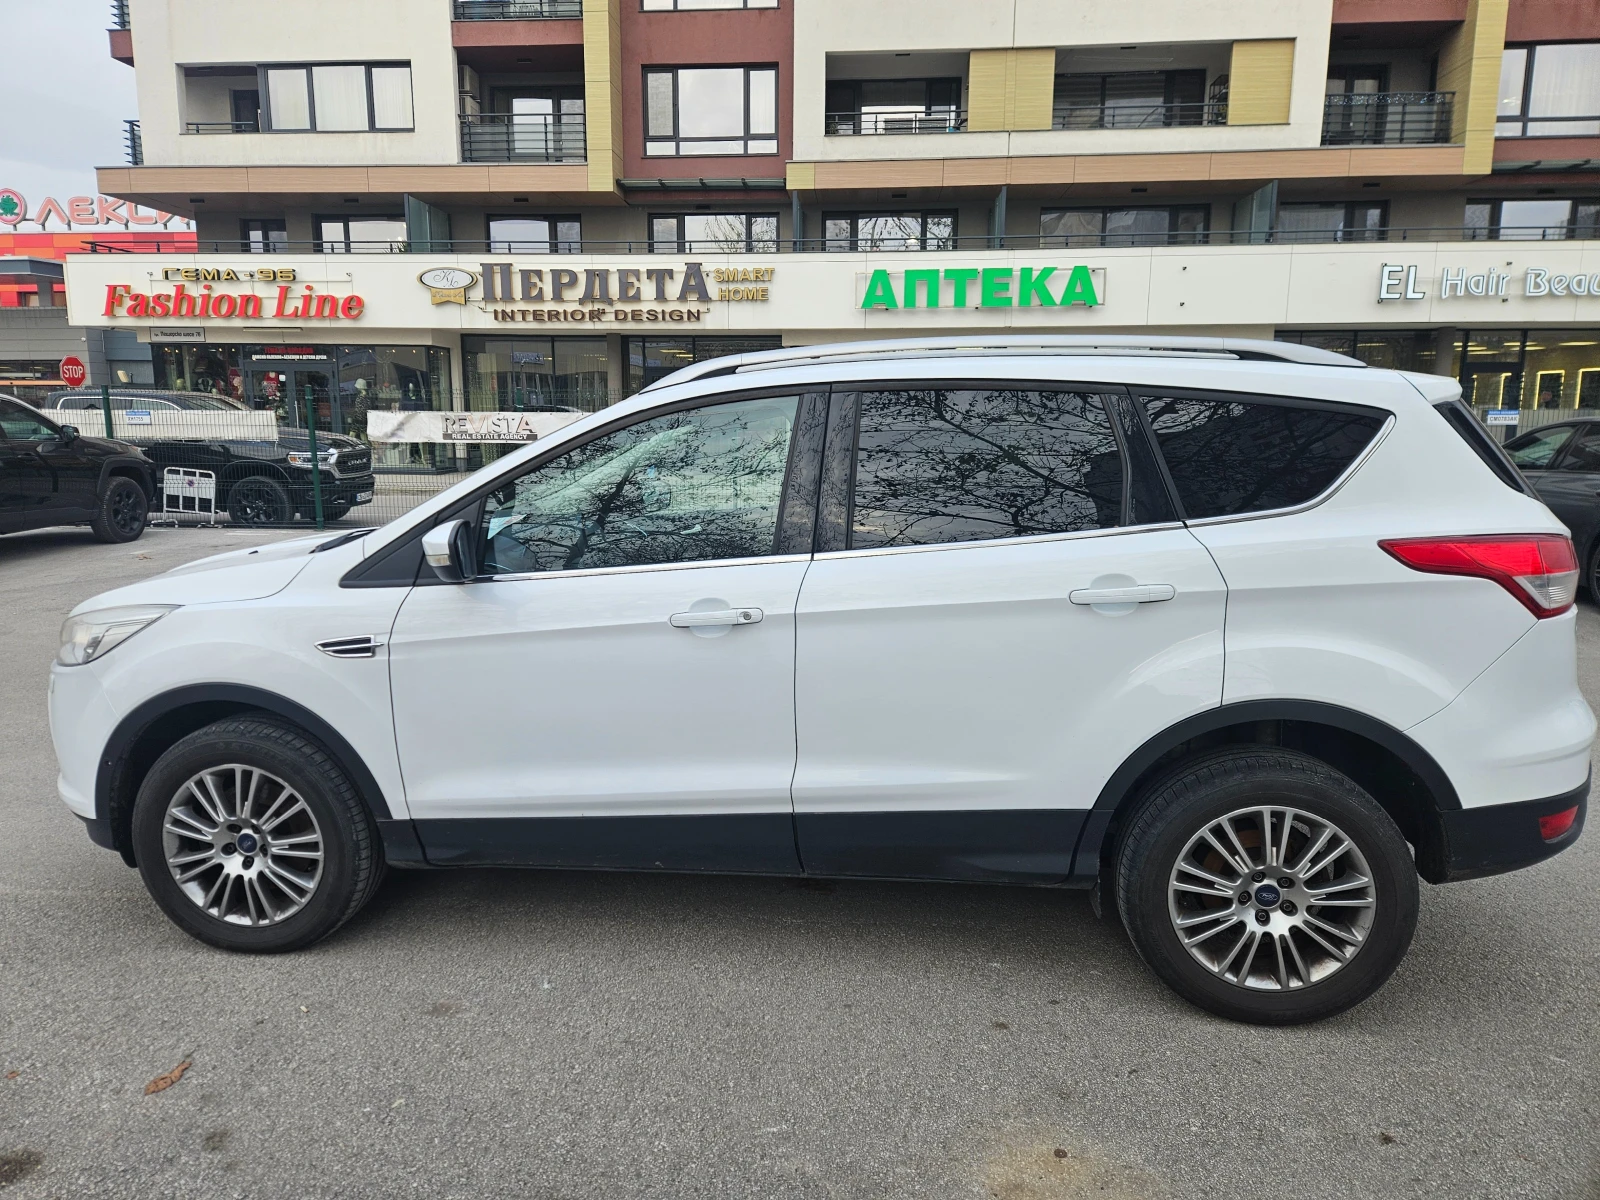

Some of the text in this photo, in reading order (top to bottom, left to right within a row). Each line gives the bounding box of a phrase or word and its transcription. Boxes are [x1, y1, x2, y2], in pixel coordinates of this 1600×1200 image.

[480, 262, 711, 306] ПЕРДЕТА
[713, 268, 775, 282] SMART
[1379, 265, 1425, 299] EL
[1441, 267, 1511, 299] Hair
[718, 287, 769, 300] HOME
[861, 266, 1098, 308] АПТЕКА
[101, 284, 364, 319] Fashion Line
[494, 309, 700, 321] INTERIOR DESIGN
[63, 366, 83, 378] STOP
[441, 415, 537, 433] REVISTA
